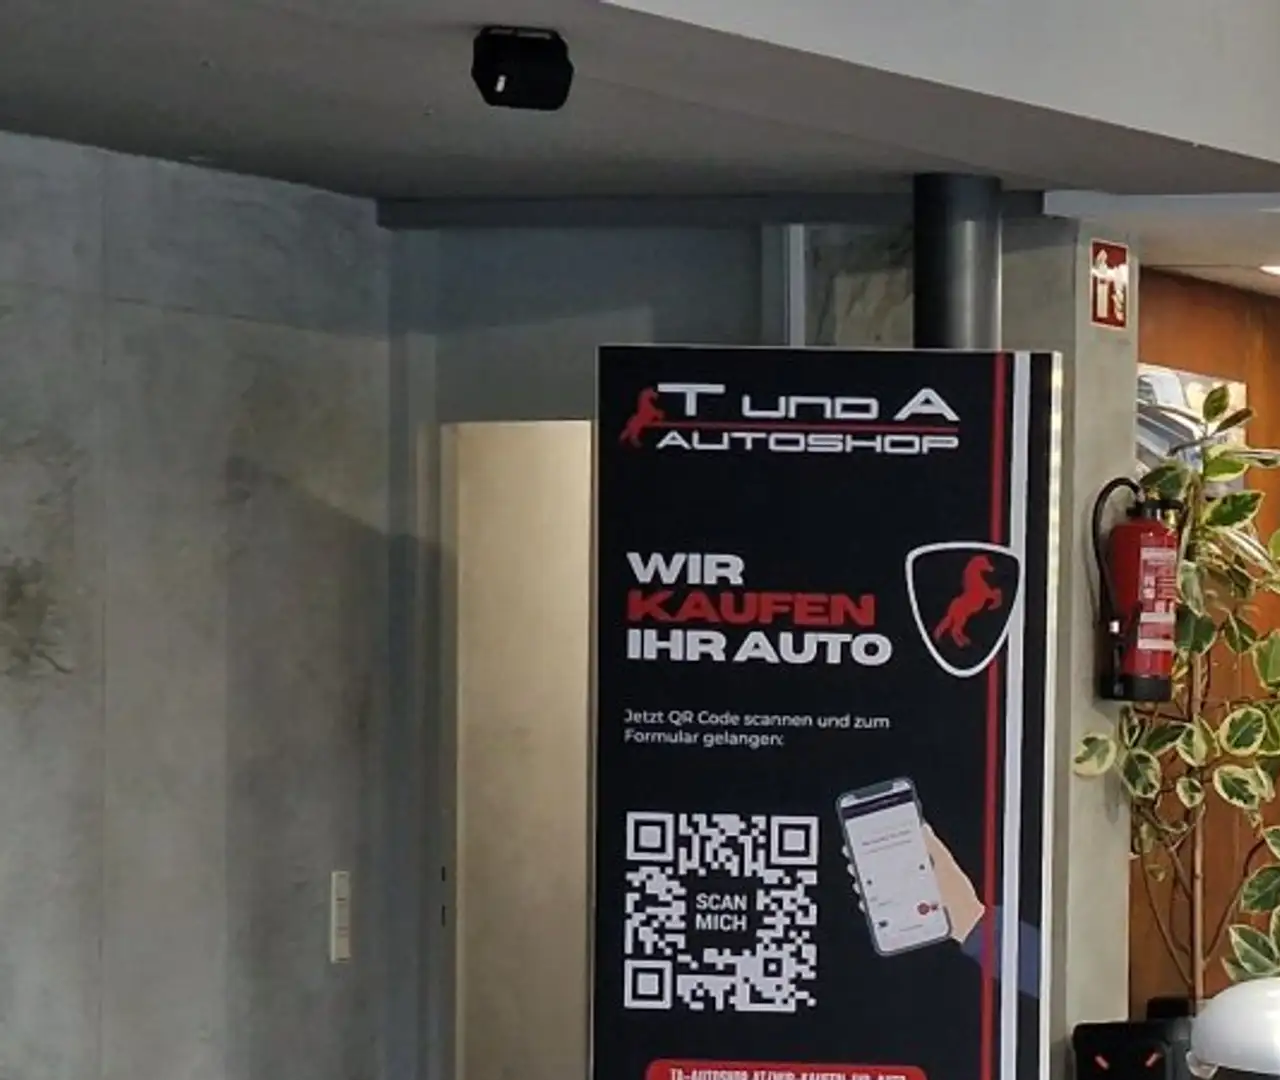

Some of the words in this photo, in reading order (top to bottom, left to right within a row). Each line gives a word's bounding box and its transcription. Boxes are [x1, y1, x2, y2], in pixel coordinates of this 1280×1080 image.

[657, 383, 725, 416] T
[893, 387, 960, 421] A
[656, 430, 959, 455] AUTOSHOP
[626, 552, 745, 585] WIR
[627, 589, 875, 625] KAUFEN
[626, 629, 726, 662] IHR
[733, 631, 893, 667] AUTO
[624, 709, 664, 724] Jetzt
[668, 710, 694, 726] QR
[698, 710, 740, 726] Code
[744, 712, 812, 726] scannen
[817, 714, 850, 729] und
[854, 717, 890, 729] zum
[624, 728, 699, 744] Formular
[696, 892, 748, 911] SCAN
[696, 913, 748, 931] MICH
